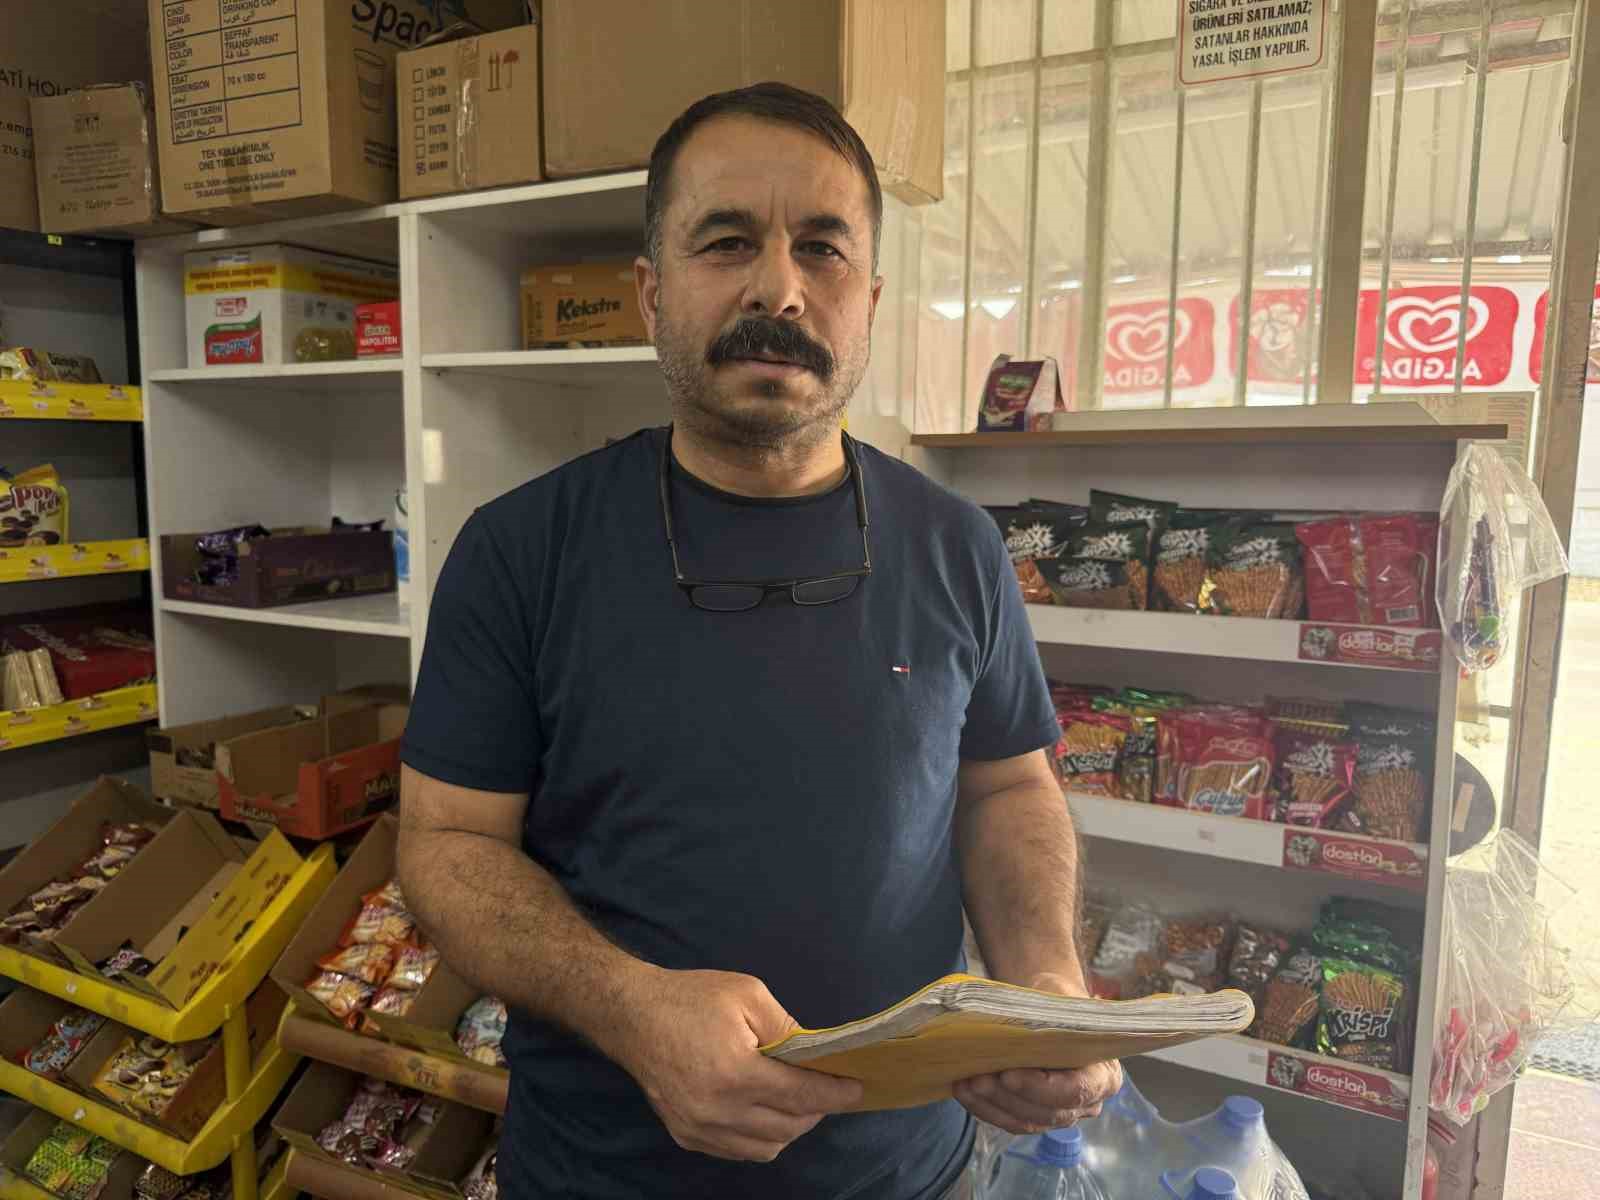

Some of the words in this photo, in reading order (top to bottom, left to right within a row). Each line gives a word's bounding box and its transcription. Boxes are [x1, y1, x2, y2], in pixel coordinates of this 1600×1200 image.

[1193, 10, 1244, 32] ÜRÜNLERİ
[224, 33, 279, 49] TRANSPARENT
[1194, 29, 1251, 50] SATANLAR
[1253, 20, 1309, 41] HAKKINDA
[1192, 52, 1226, 68] YASAL
[1228, 46, 1262, 67] İŞLEM
[198, 160, 215, 170] ONE
[254, 150, 275, 163] ONLY
[201, 148, 217, 160] TEK
[1325, 845, 1380, 865] dostlar
[1310, 1069, 1364, 1093] dostlar
